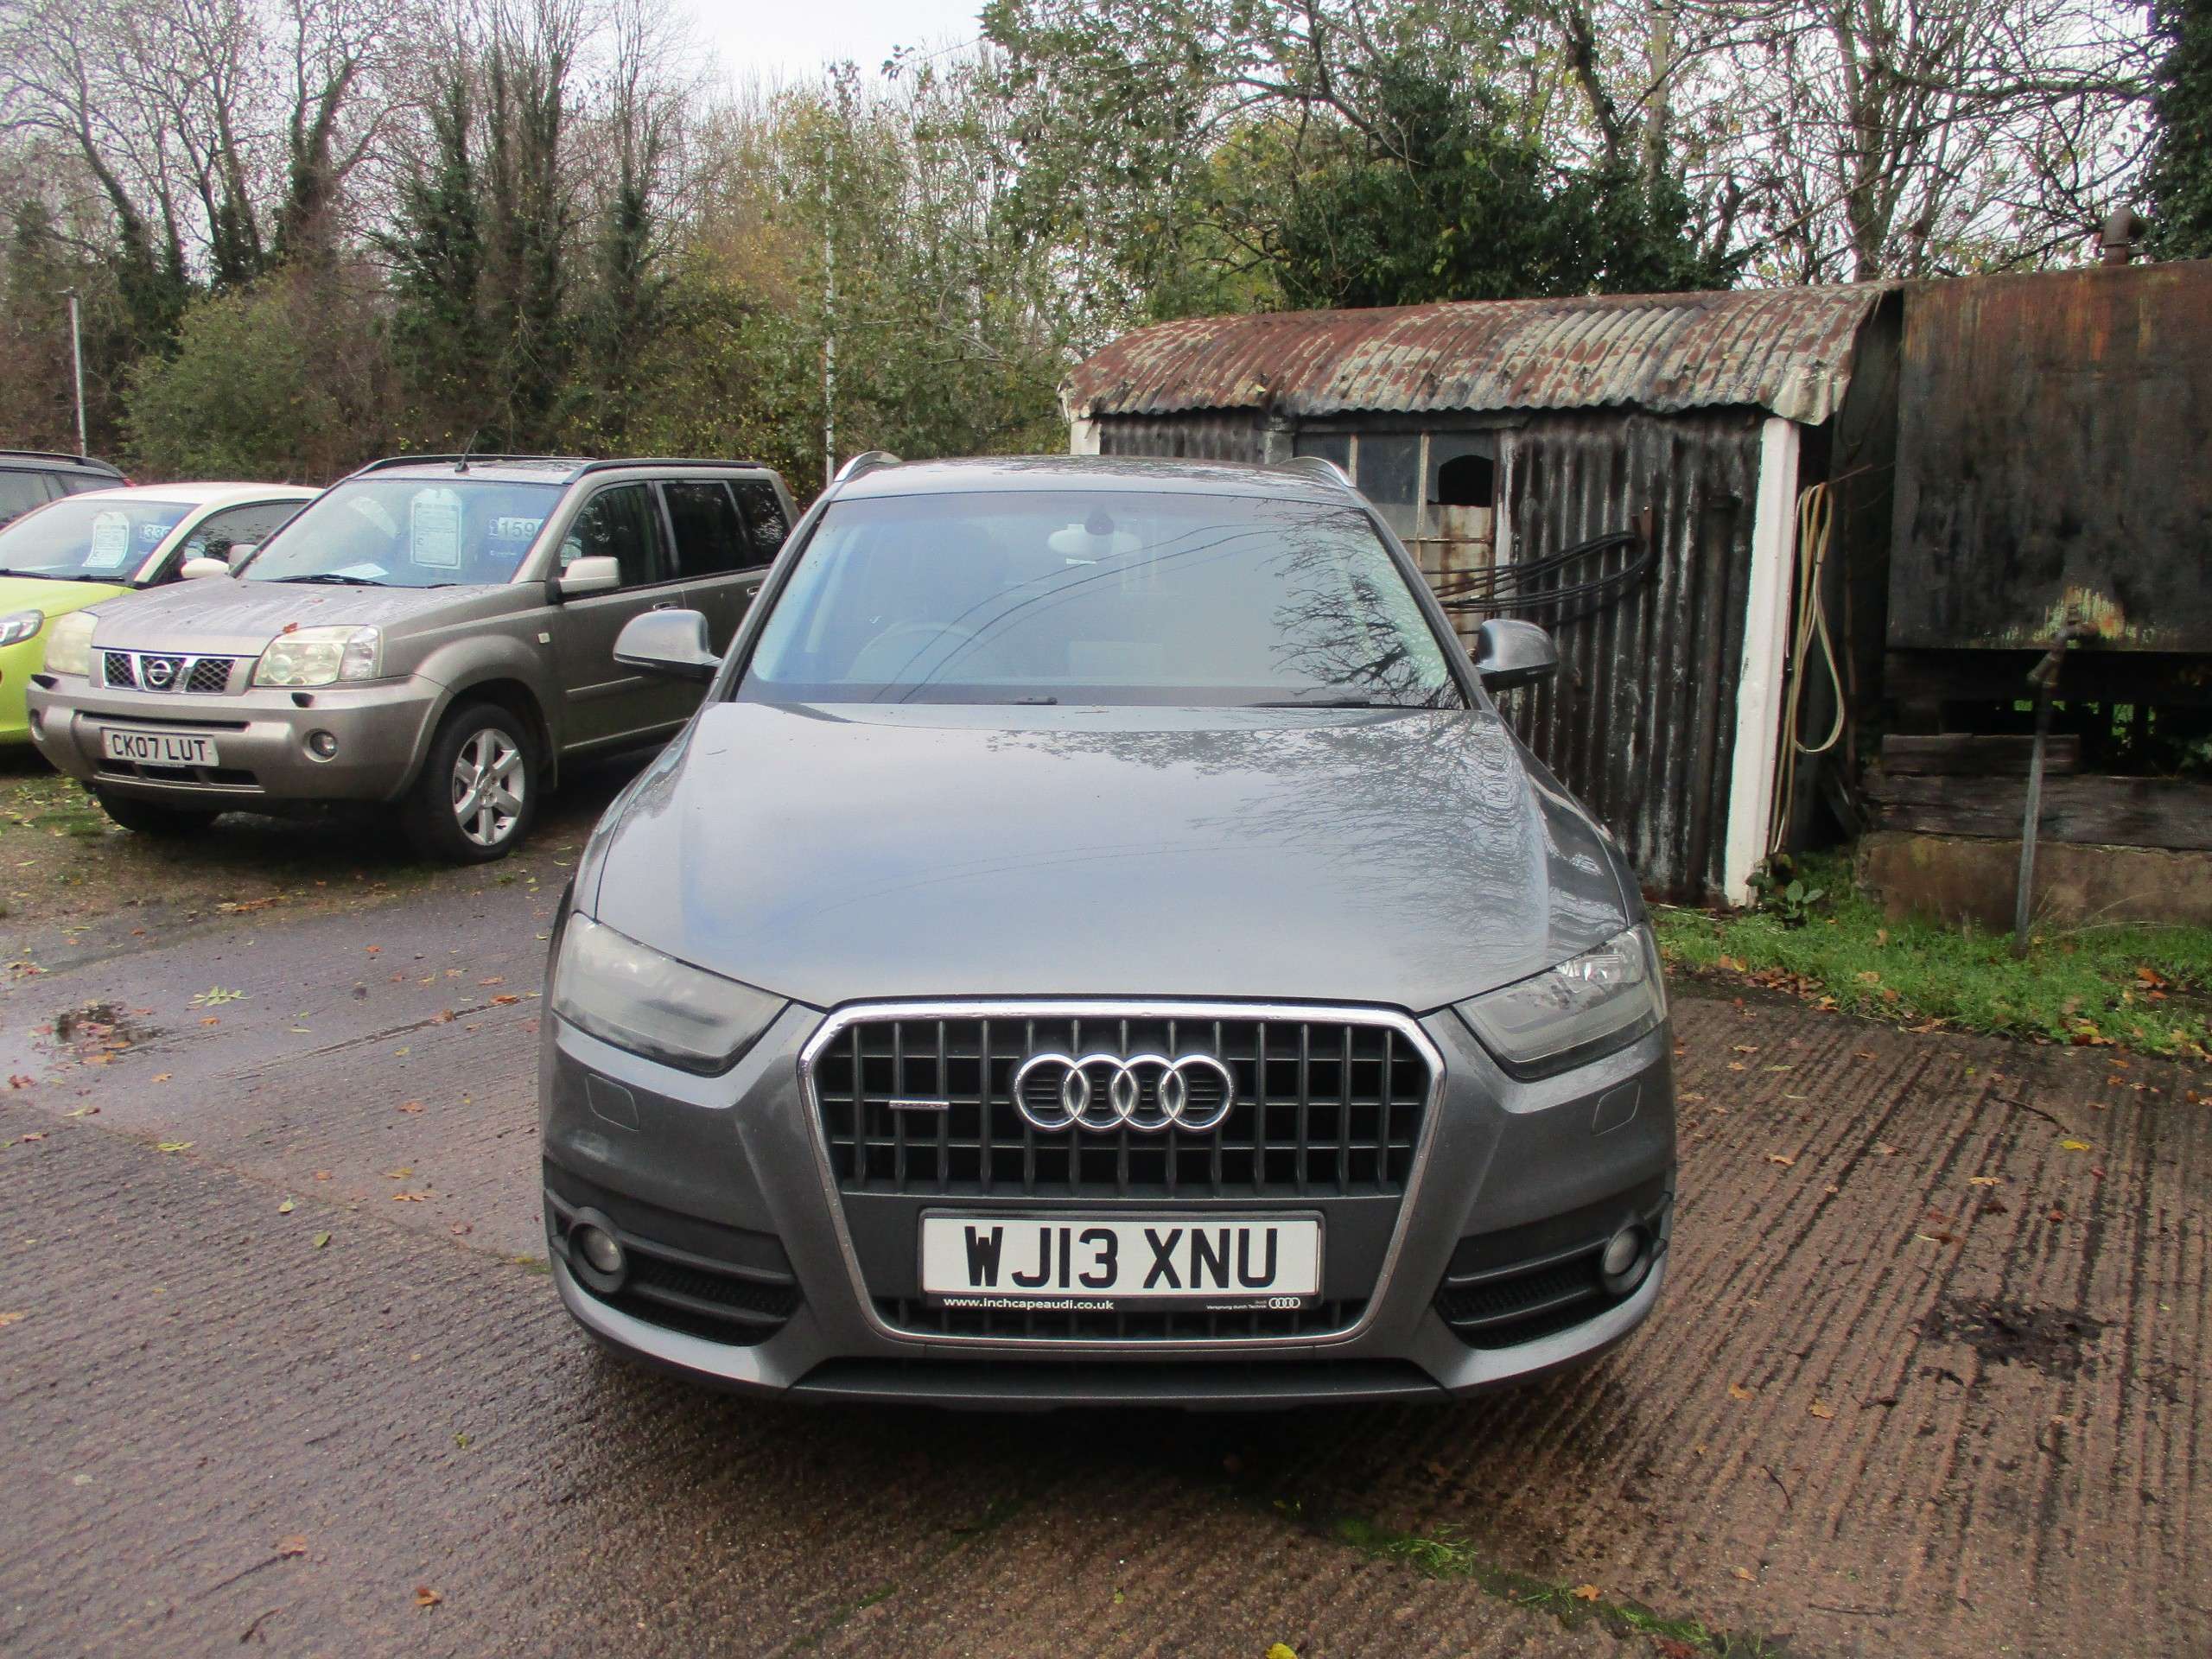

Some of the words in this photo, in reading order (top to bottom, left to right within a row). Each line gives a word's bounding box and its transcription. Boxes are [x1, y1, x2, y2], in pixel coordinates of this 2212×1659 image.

[112, 734, 159, 759] CK07
[166, 739, 206, 761] LUT
[964, 1225, 1119, 1288] WJ13
[1142, 1227, 1278, 1288] XNU
[943, 1298, 1115, 1311] www.inchcapeaudi.co.uk
